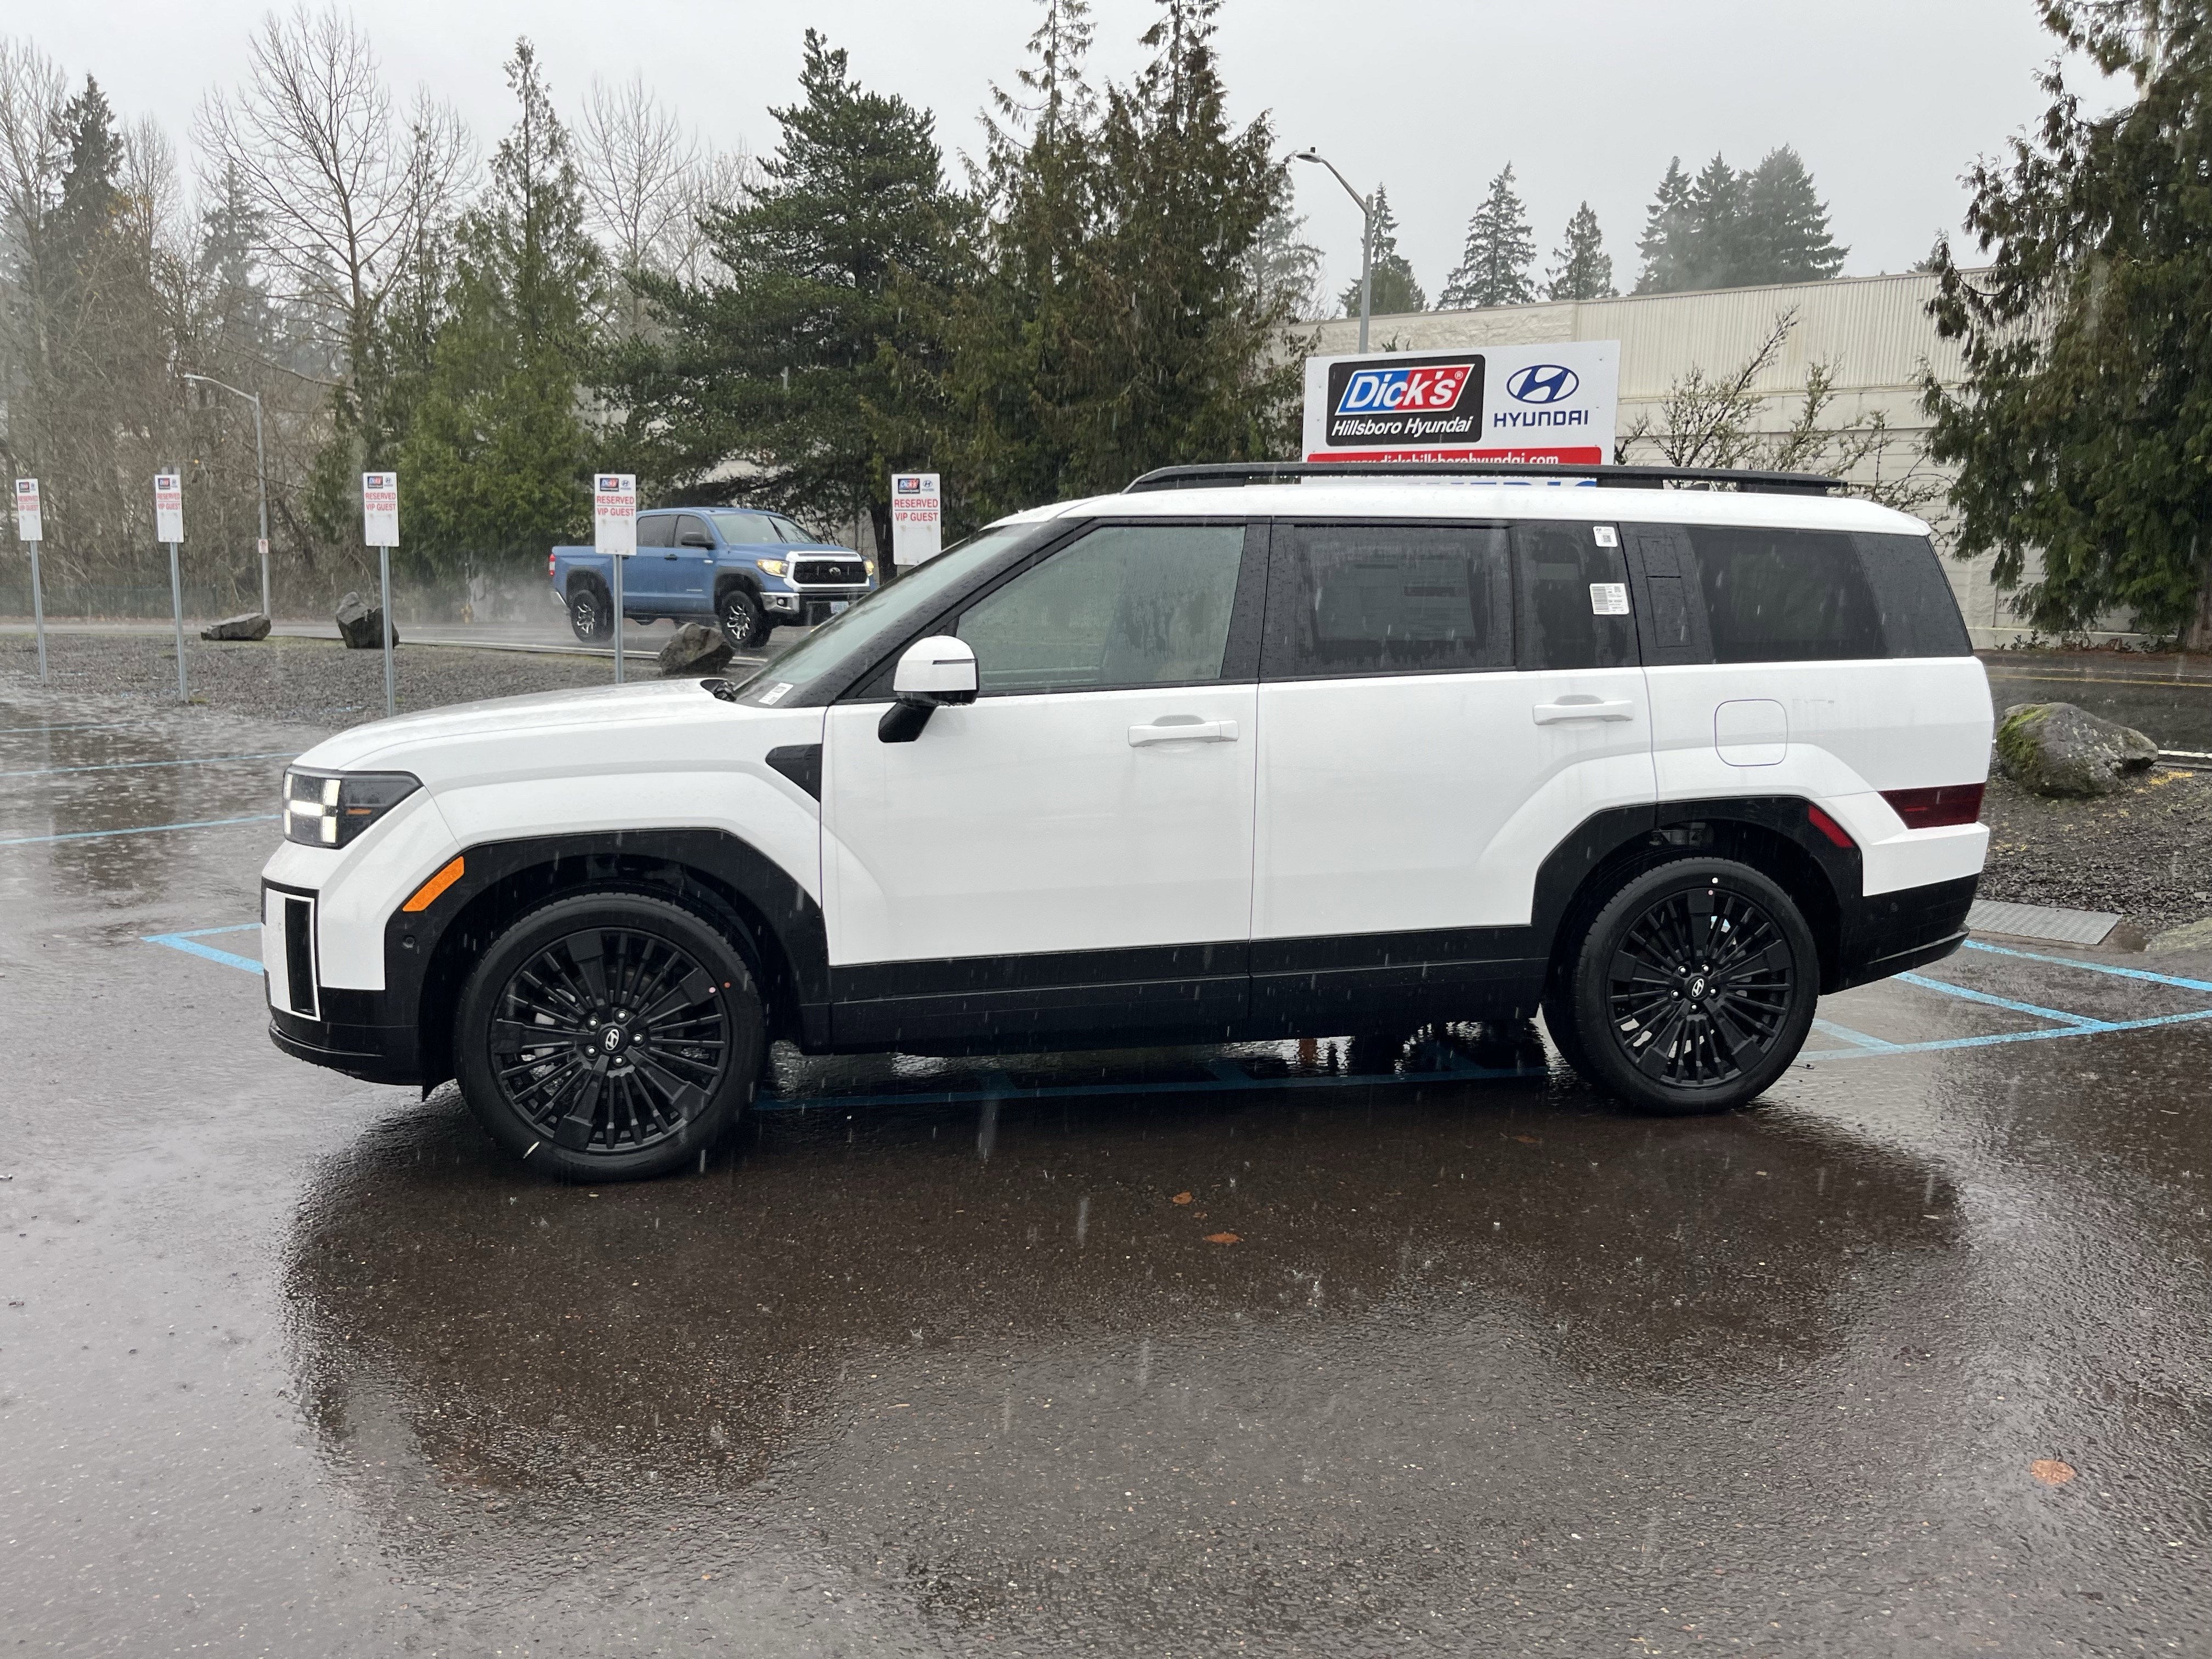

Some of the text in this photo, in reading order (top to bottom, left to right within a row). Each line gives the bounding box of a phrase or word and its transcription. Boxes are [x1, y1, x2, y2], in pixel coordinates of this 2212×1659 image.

[1493, 409, 1589, 427] HYUNDAI
[1331, 416, 1474, 438] Hillsboro Hyundai
[596, 496, 634, 504] RESERVED
[894, 499, 938, 507] RESERVED
[610, 508, 634, 516] GUEST
[895, 512, 938, 521] VIP GUEST
